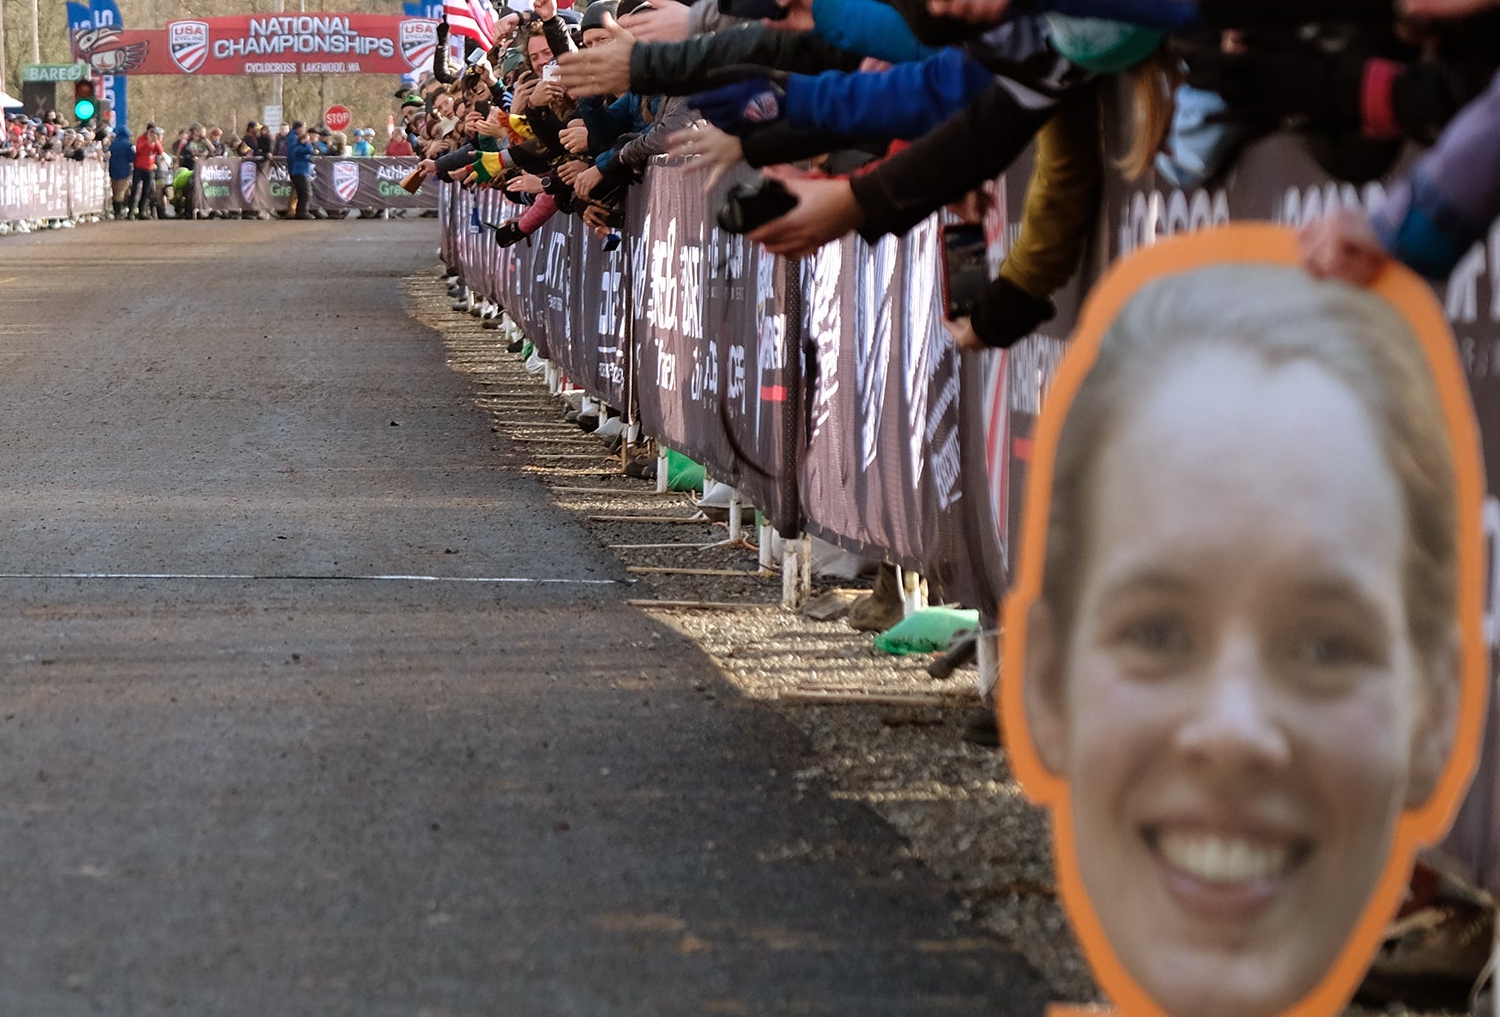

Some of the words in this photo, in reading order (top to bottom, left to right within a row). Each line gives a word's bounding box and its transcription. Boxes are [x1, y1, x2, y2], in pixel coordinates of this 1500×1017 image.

[174, 25, 203, 35] USA
[250, 16, 358, 36] NATIONAL
[405, 24, 433, 34] USA
[213, 35, 395, 58] CHAMPIONSHIPS
[30, 67, 67, 81] BARE
[245, 62, 297, 73] CYCLOCROSS
[326, 112, 350, 124] STOP
[201, 165, 233, 180] Athletic
[203, 183, 230, 197] Greens
[270, 182, 292, 197] Gre
